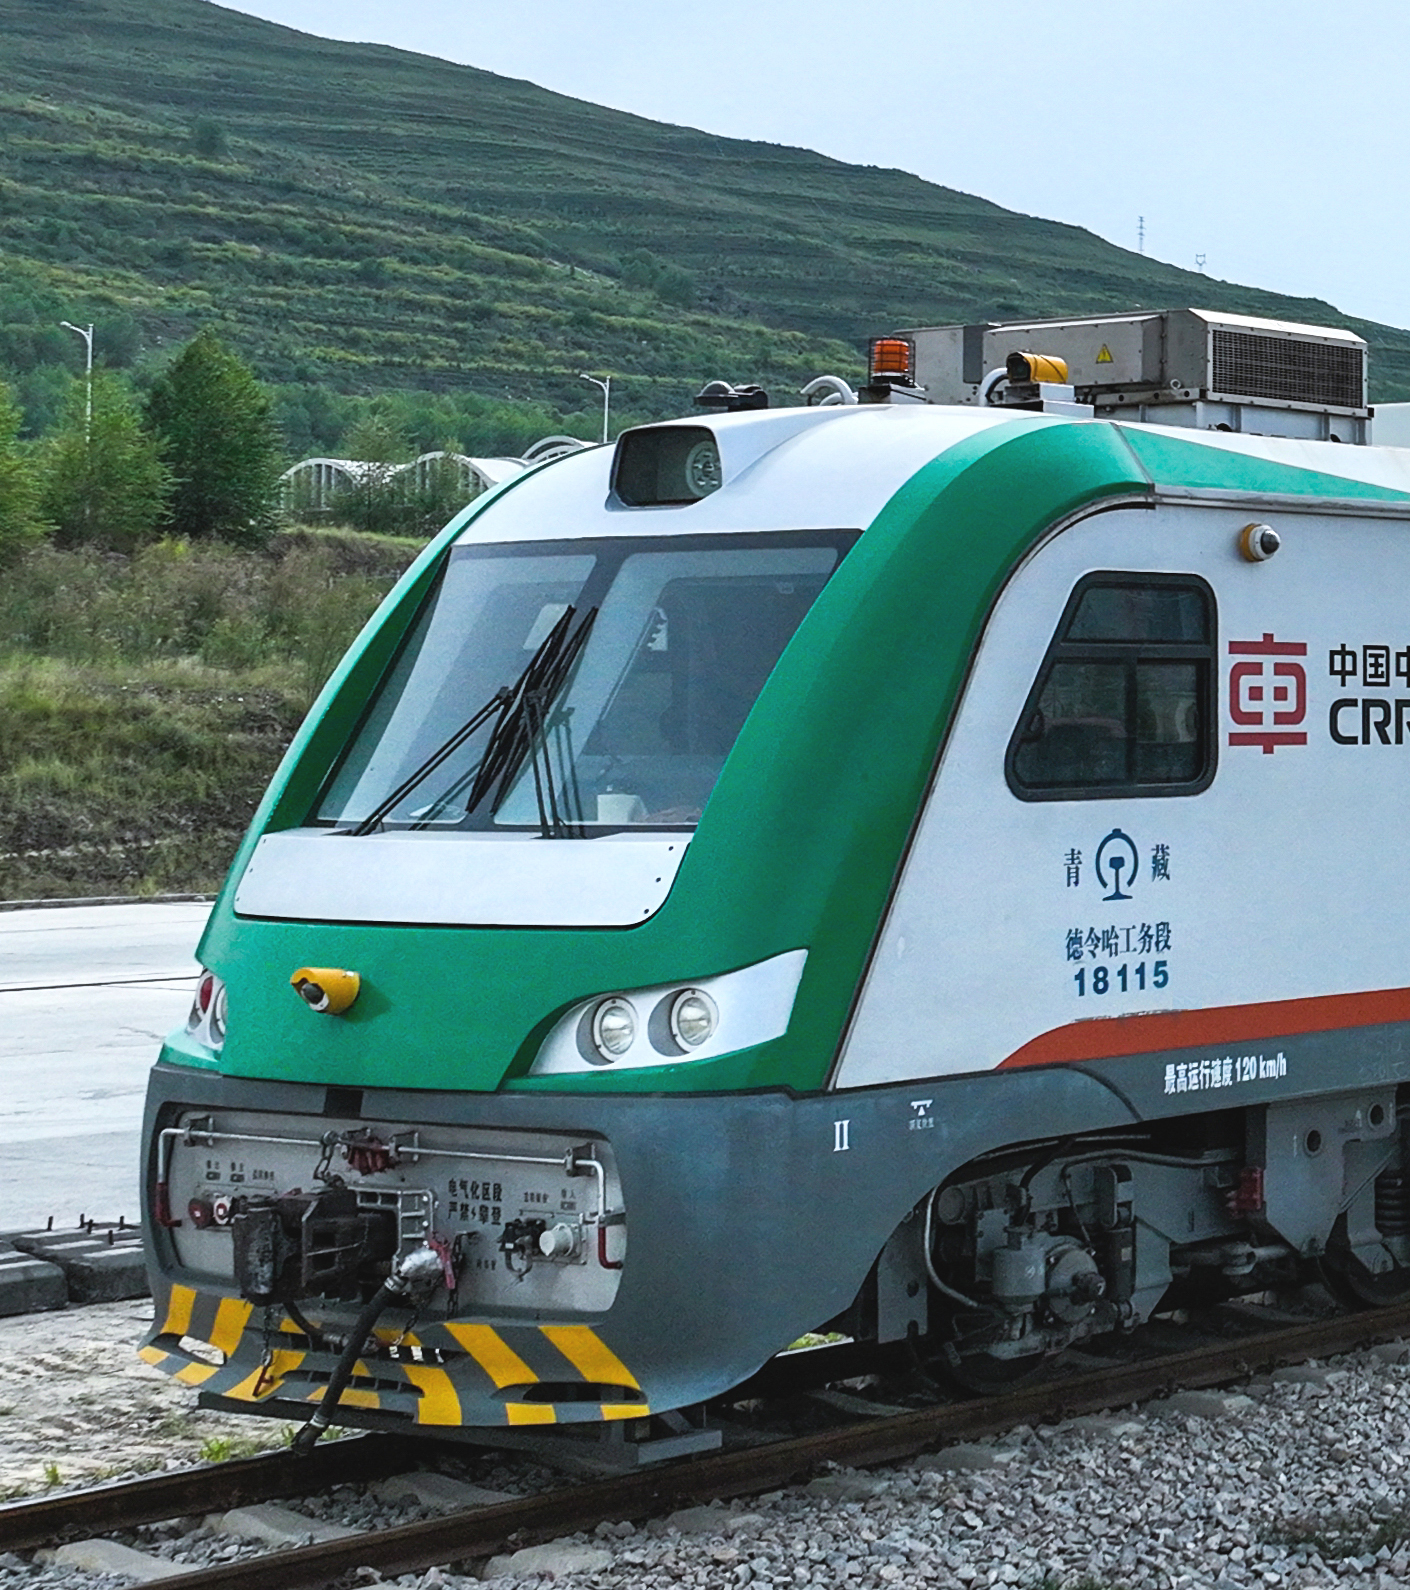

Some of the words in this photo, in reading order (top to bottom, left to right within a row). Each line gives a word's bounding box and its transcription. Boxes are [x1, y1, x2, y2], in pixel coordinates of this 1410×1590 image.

[1063, 848, 1083, 887] 青
[1151, 843, 1171, 882] 藏
[1065, 921, 1172, 961] 德令哈工务段
[1074, 960, 1169, 996] 18115
[1164, 1056, 1233, 1095] 最高运行速度
[1235, 1056, 1257, 1082] 120
[1259, 1052, 1287, 1079] km/h
[448, 1178, 502, 1202] 电气化区段
